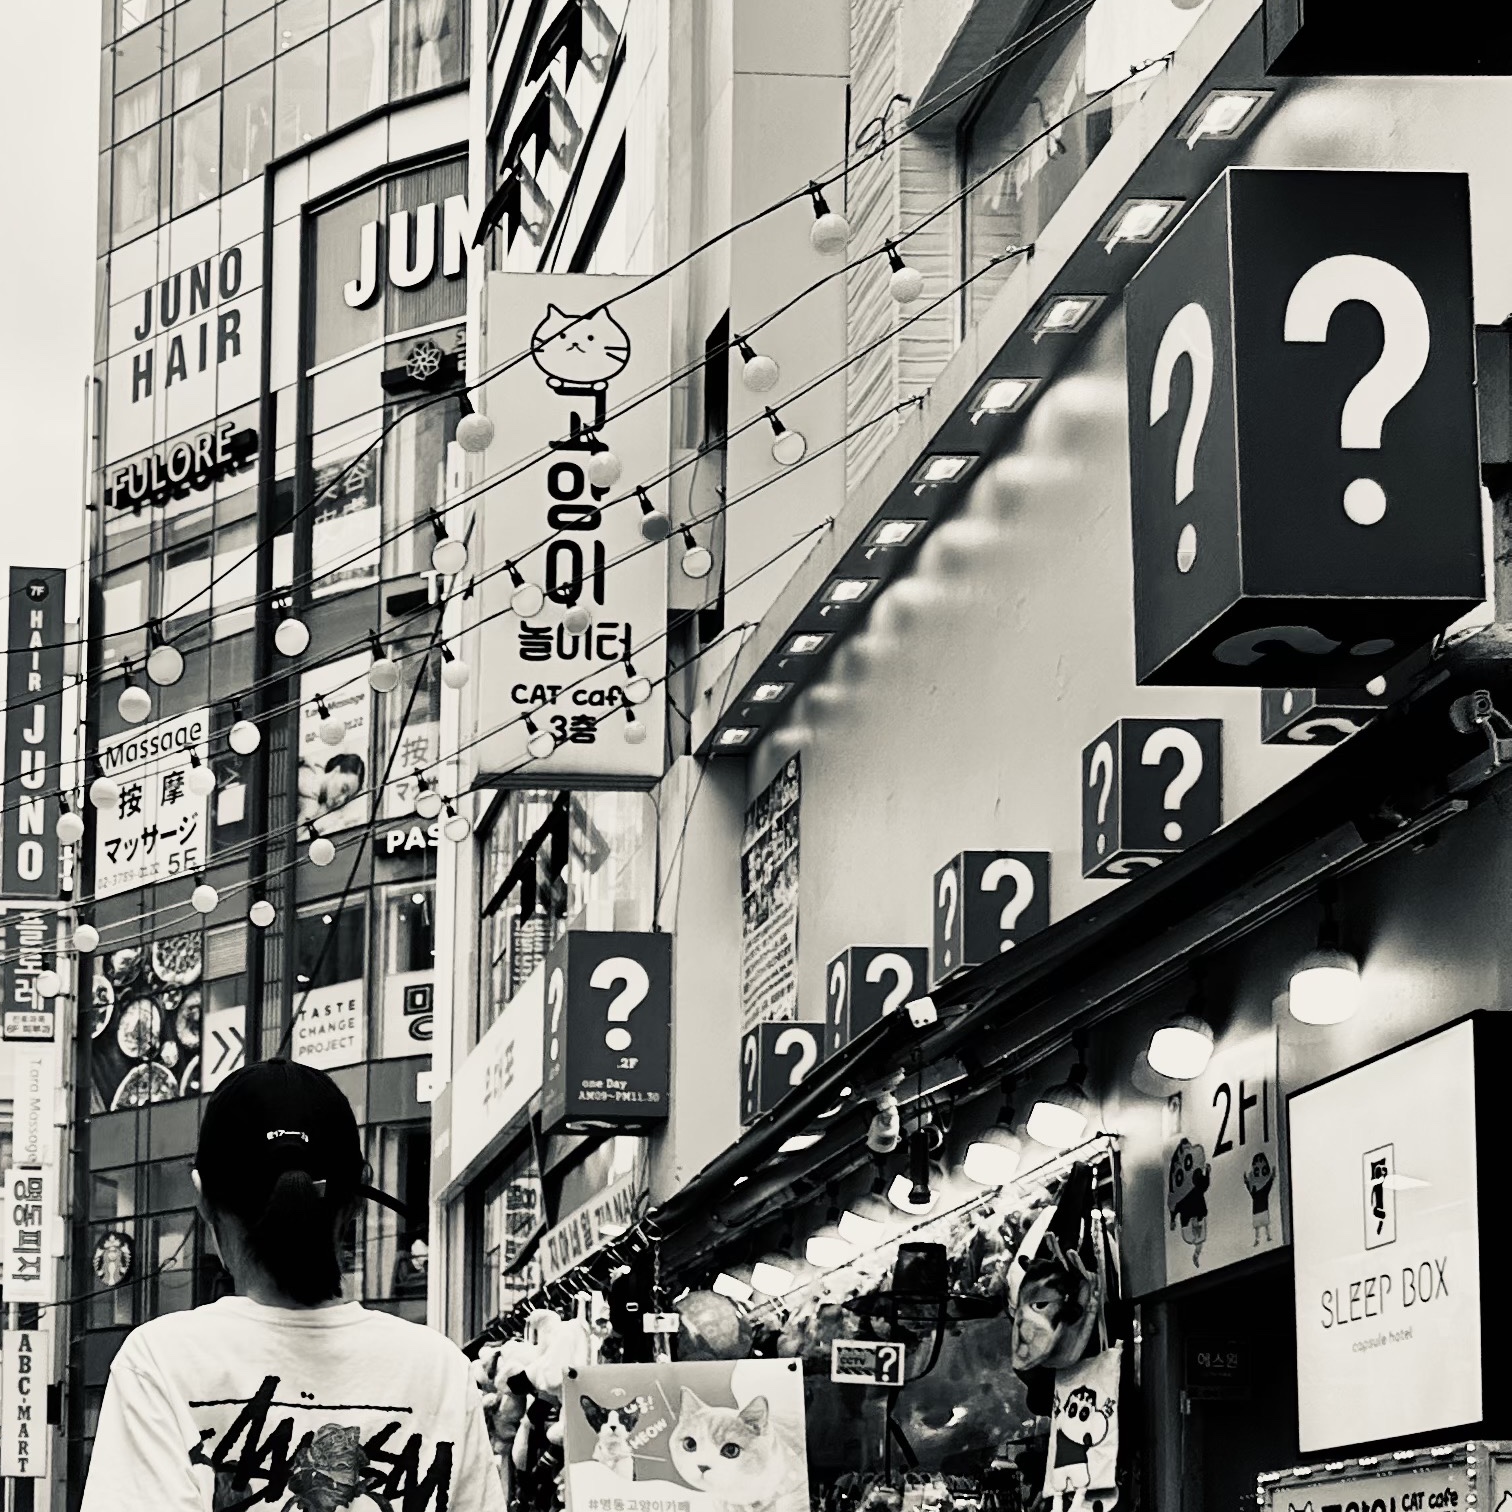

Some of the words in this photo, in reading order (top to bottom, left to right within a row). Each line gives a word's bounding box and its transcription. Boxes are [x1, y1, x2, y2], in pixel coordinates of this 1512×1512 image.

[134, 247, 242, 341] JUNO
[132, 308, 241, 404] HAIR
[111, 421, 236, 507] FULORE
[545, 384, 608, 606] 고양이
[28, 610, 44, 692] HAIR
[518, 621, 631, 662] 놀이터
[511, 684, 562, 705] CAT
[572, 684, 638, 707] caf
[105, 721, 202, 770] Massage
[550, 713, 597, 744] 3층
[17, 704, 46, 881] JUNO
[104, 812, 199, 864] マッサージ
[299, 999, 356, 1021] TASTE
[299, 1018, 355, 1038] CHANGE
[299, 1036, 355, 1056] PROJECT
[1321, 1273, 1392, 1329] SLEEP
[1402, 1255, 1449, 1308] BOX
[628, 1417, 668, 1450] MEOW
[1401, 1491, 1425, 1512] CAT
[1428, 1487, 1458, 1509] cafe
